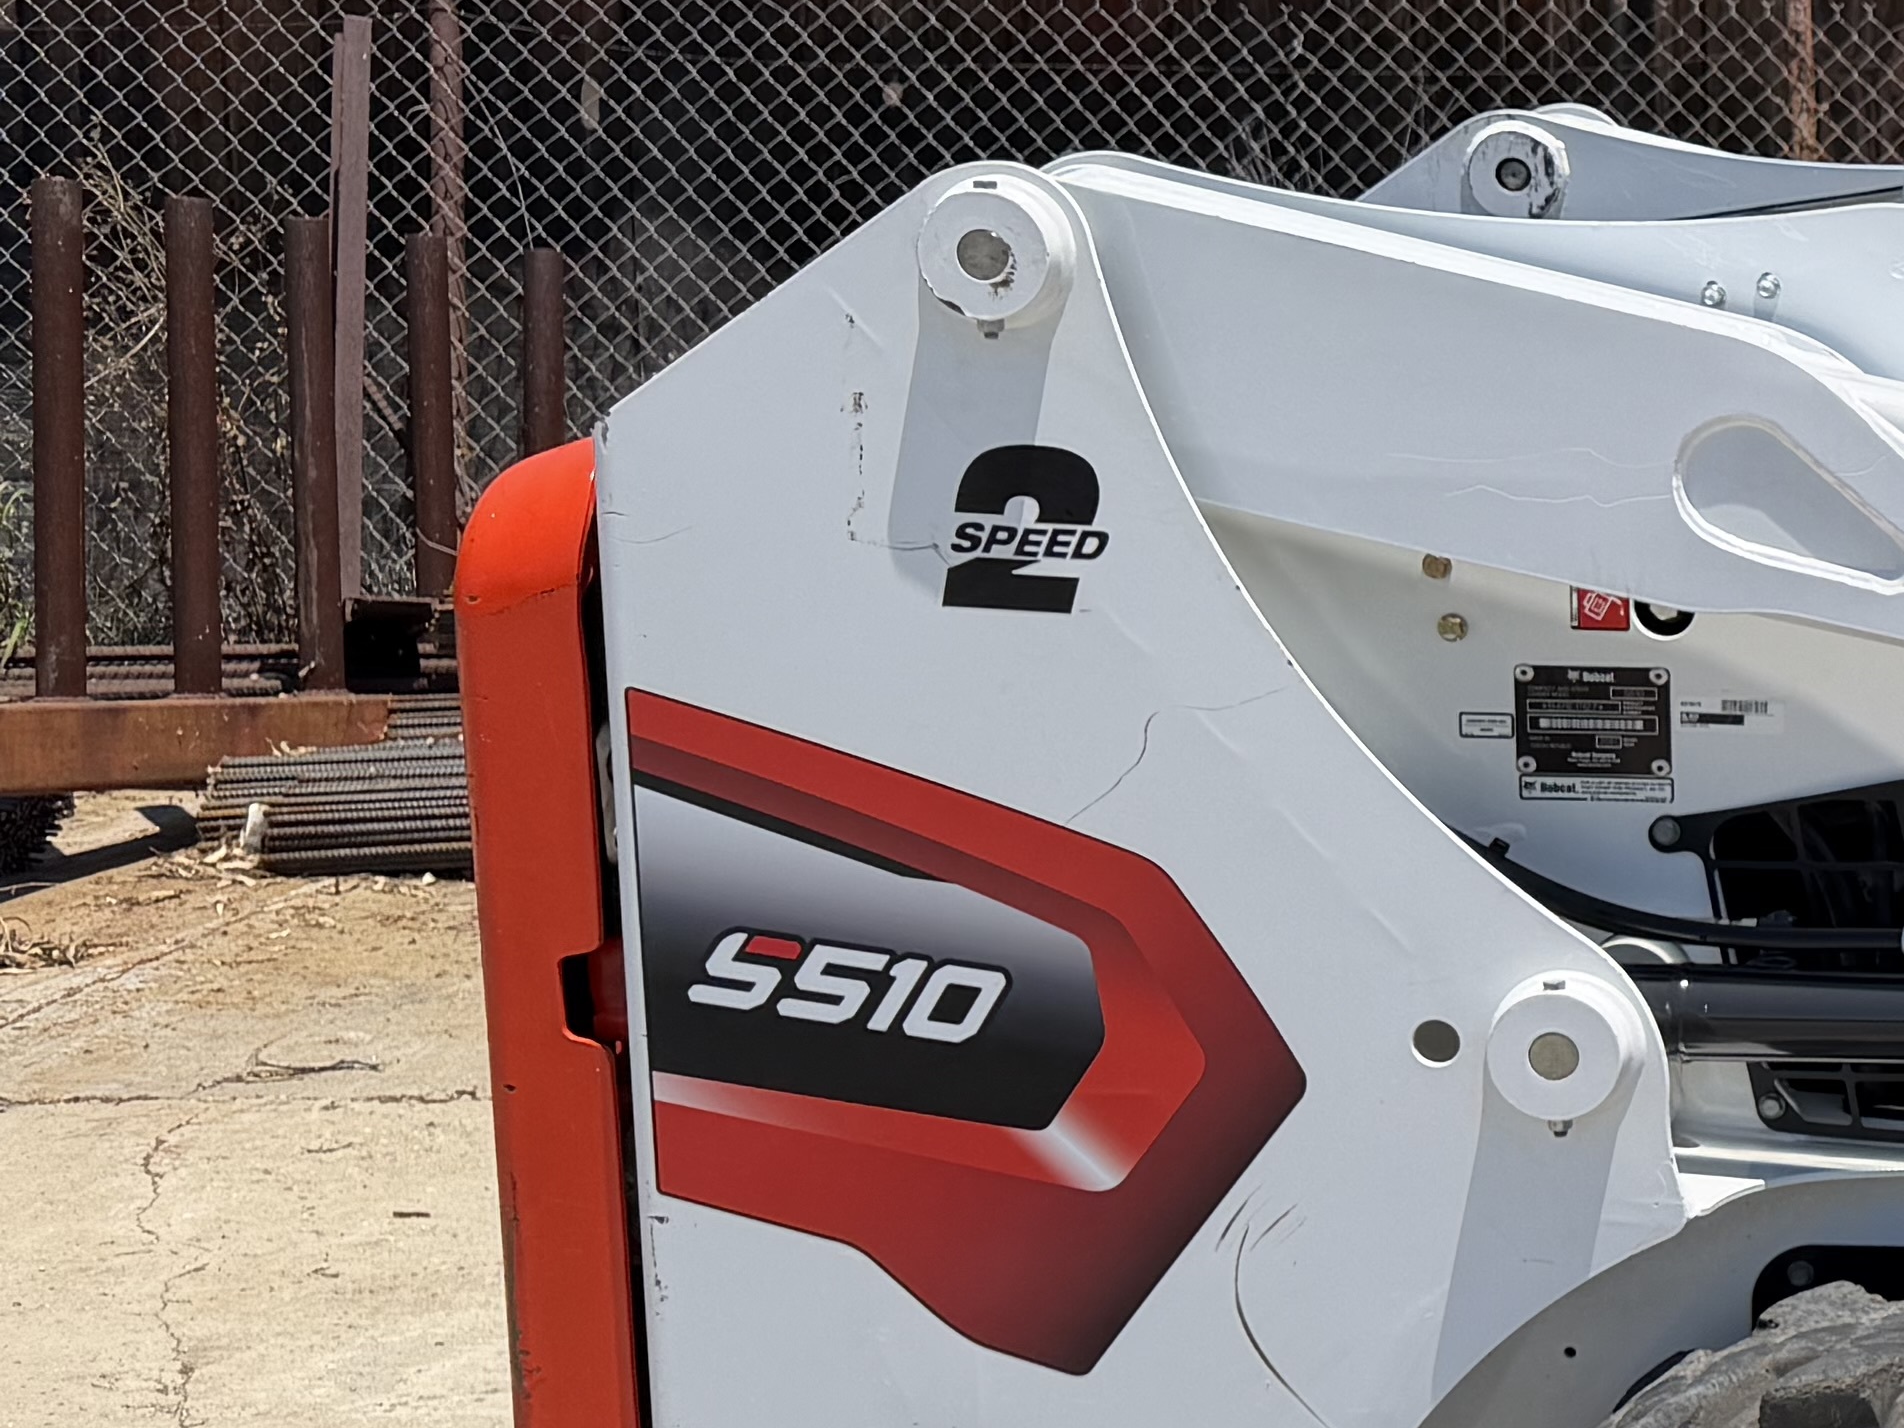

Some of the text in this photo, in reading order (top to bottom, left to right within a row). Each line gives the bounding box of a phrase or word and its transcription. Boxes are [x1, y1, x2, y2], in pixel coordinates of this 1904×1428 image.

[942, 444, 1100, 614] 2
[950, 522, 1110, 560] SPEED
[687, 931, 1007, 1044] S510
